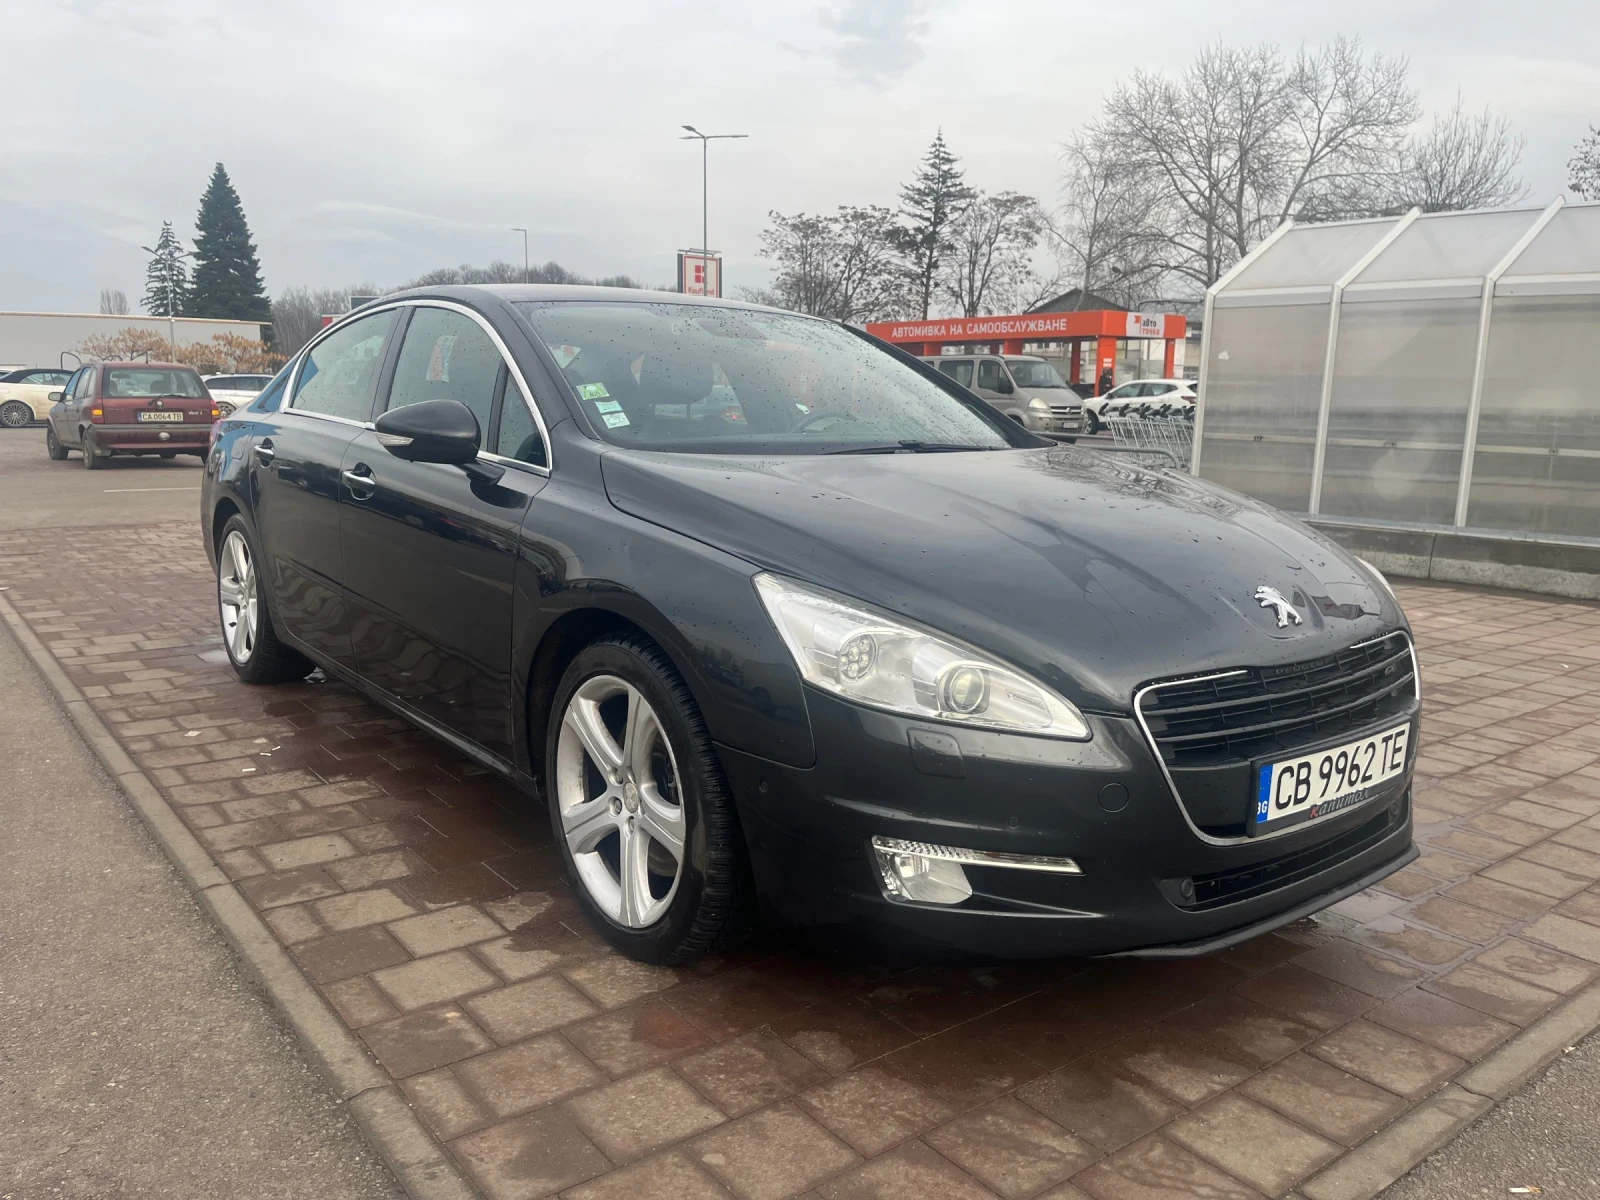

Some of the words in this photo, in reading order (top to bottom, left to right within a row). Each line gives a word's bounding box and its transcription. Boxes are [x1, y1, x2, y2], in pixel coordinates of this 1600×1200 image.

[688, 287, 714, 295] Kauflnd
[892, 324, 946, 338] АВТОМИВКА
[949, 324, 963, 336] НА
[966, 318, 1067, 335] САМООБСЛУЖВАНЕ
[1142, 319, 1157, 327] авто
[1275, 761, 1312, 810] CB
[1319, 742, 1376, 798] 9962
[1381, 729, 1406, 776] TE
